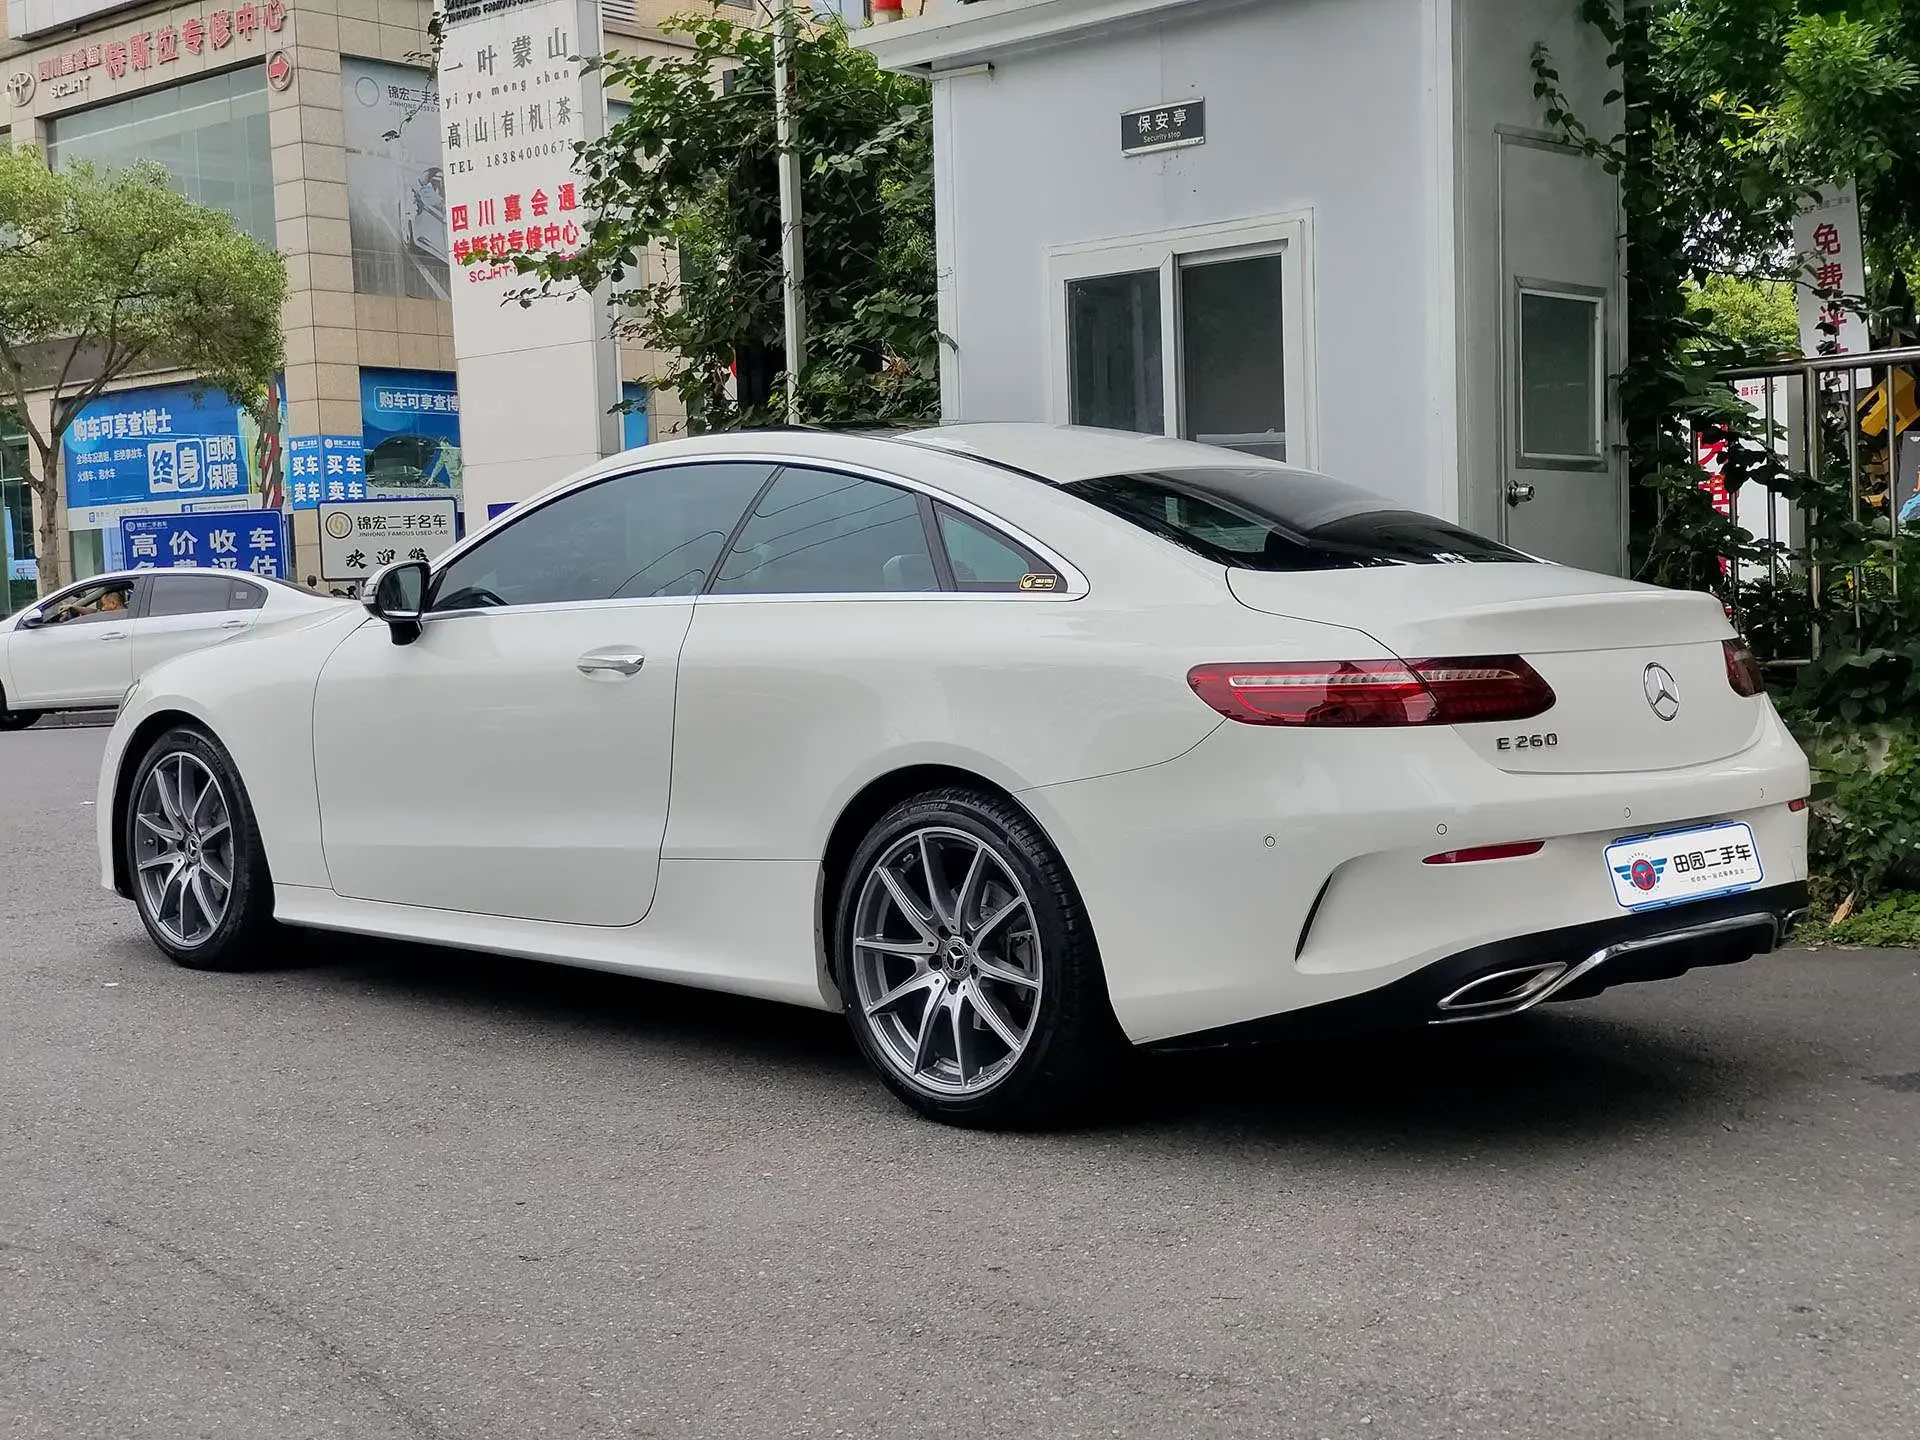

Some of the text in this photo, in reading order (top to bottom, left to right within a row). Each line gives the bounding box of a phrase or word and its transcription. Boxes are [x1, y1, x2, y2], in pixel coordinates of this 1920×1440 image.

[104, 0, 285, 79] 特斯拉专修中心
[443, 27, 568, 76] 一叶蒙山
[536, 69, 570, 86] shan
[1138, 108, 1187, 134] 保安亭
[449, 138, 574, 175] TEL 18384000675
[451, 182, 577, 232] 四川嘉会通
[453, 219, 580, 265] 特斯拉专修中心
[73, 408, 172, 442] 购车可享查博士
[206, 436, 237, 463] 回购
[150, 447, 201, 486] 终身
[207, 464, 239, 490] 保障
[292, 455, 319, 476] 买车
[327, 455, 362, 475] 买车
[294, 481, 320, 503] 卖车
[328, 481, 364, 500] 卖车
[357, 514, 447, 530] 锦宏二手名车
[130, 527, 277, 558] 高价收车
[1496, 732, 1558, 750] E 260
[1673, 844, 1752, 873] 田园二手车
